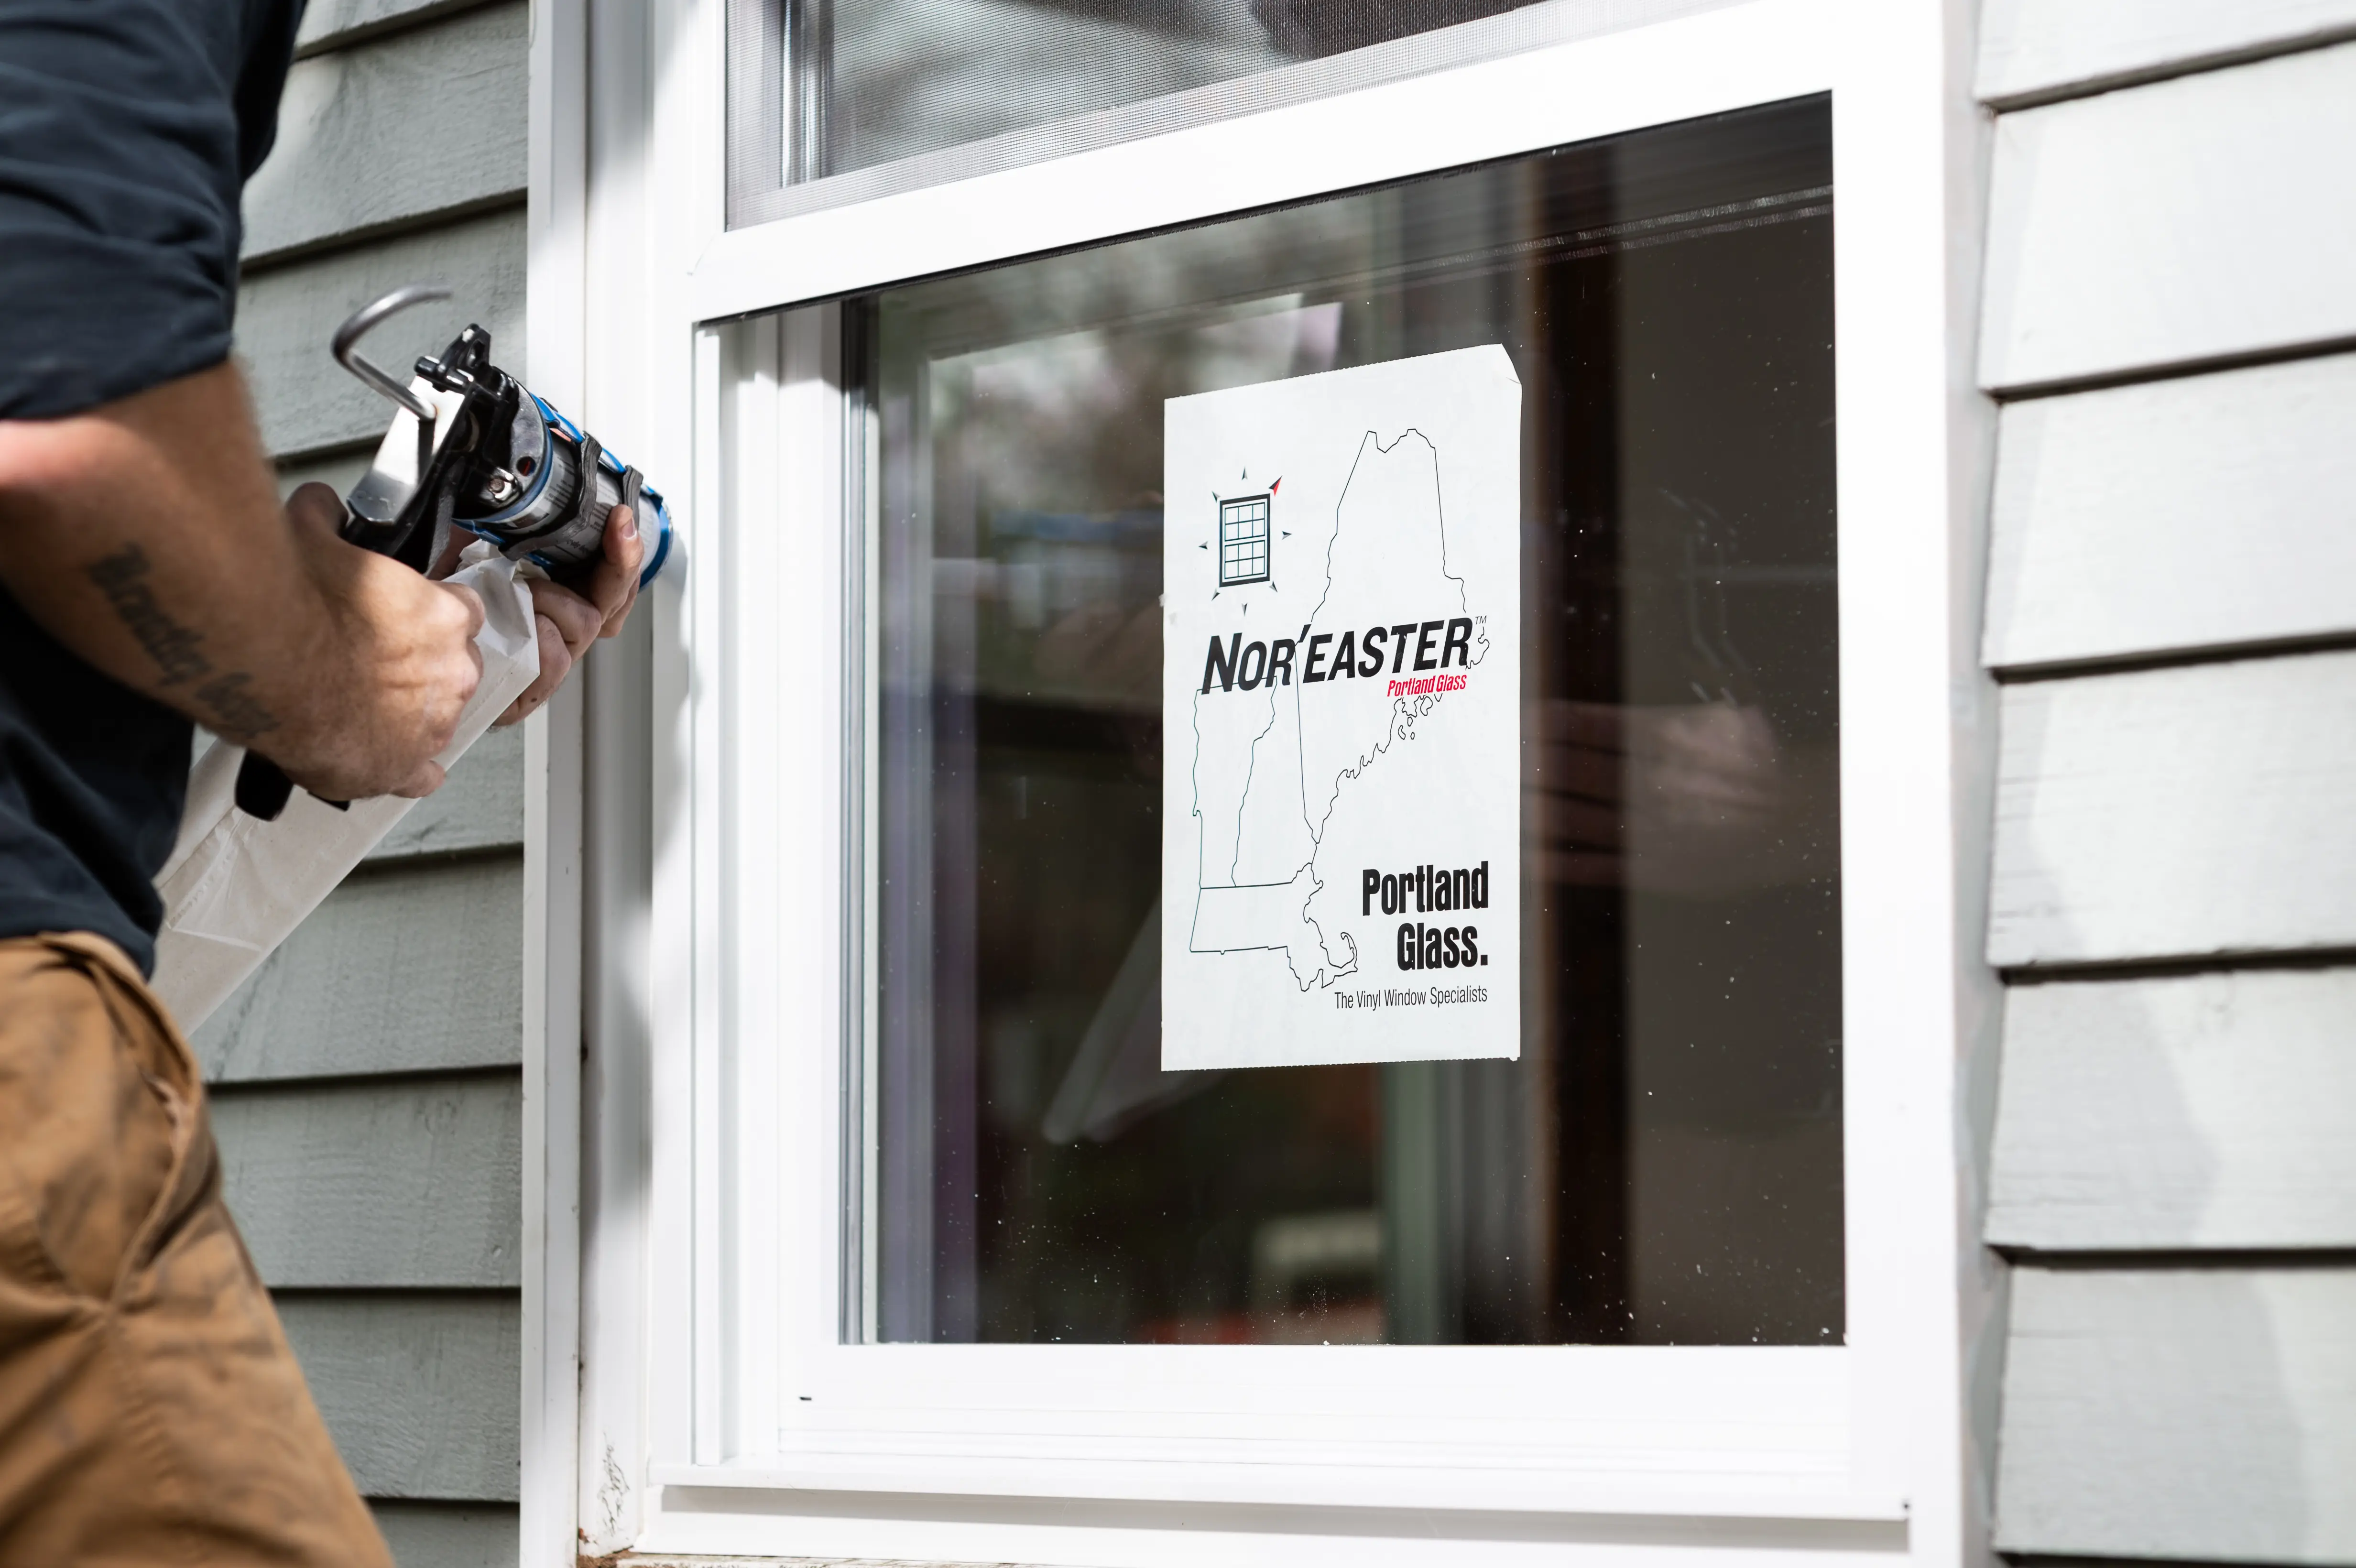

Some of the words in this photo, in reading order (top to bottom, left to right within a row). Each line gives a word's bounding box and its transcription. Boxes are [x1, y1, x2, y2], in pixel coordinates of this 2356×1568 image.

[1387, 675, 1436, 697] Portland
[1436, 674, 1467, 692] Glass
[1363, 860, 1489, 916] Portland
[1397, 922, 1488, 971] Glass.
[1334, 991, 1353, 1009] The
[1357, 990, 1381, 1011] Vinyl
[1384, 988, 1427, 1007] Window
[1430, 985, 1487, 1008] Specialists
